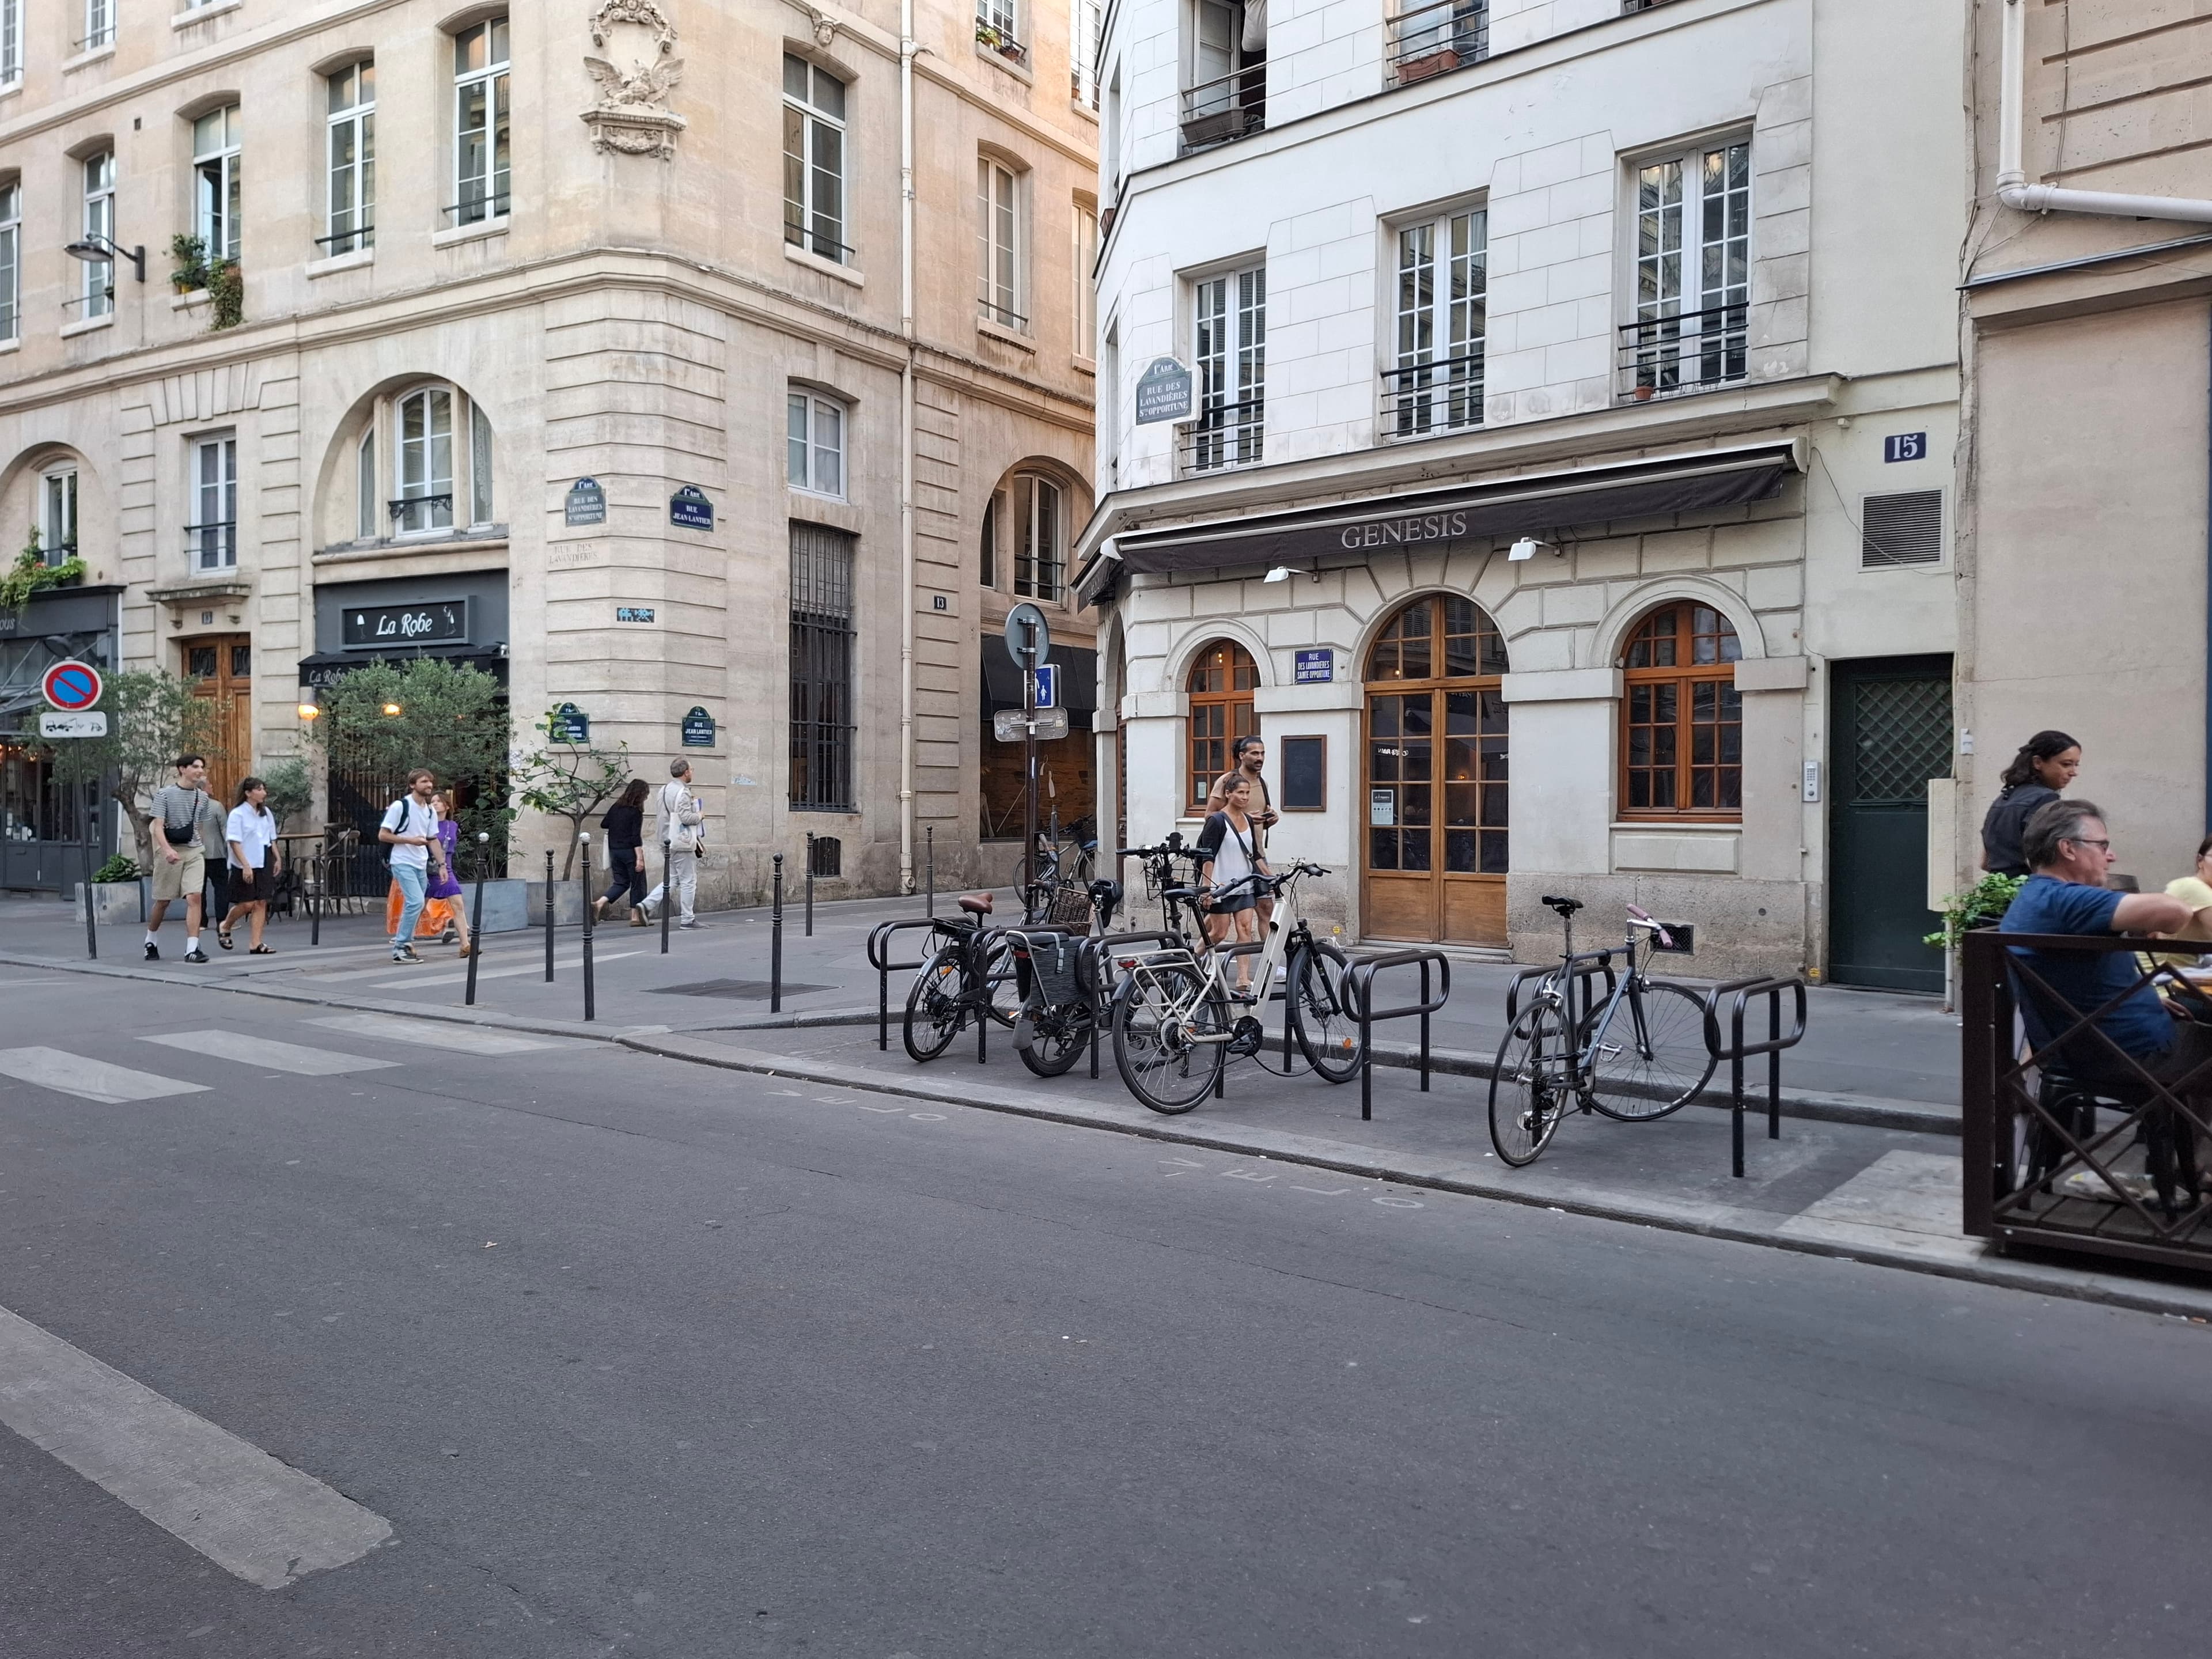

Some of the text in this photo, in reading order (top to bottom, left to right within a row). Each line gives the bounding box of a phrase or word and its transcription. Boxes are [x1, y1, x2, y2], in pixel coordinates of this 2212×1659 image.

[1147, 381, 1180, 395] RUE DES
[1140, 391, 1187, 406] LAVANDIÈRES
[1148, 401, 1188, 415] OPPORTUNE
[1893, 434, 1918, 459] 15
[686, 505, 698, 513] RUE
[673, 513, 711, 525] JEAN LANTIER
[1341, 512, 1467, 548] GENESIS
[937, 597, 944, 608] 13
[376, 612, 433, 637] La Robe
[308, 670, 321, 683] La
[1297, 671, 1309, 679] SAINTE
